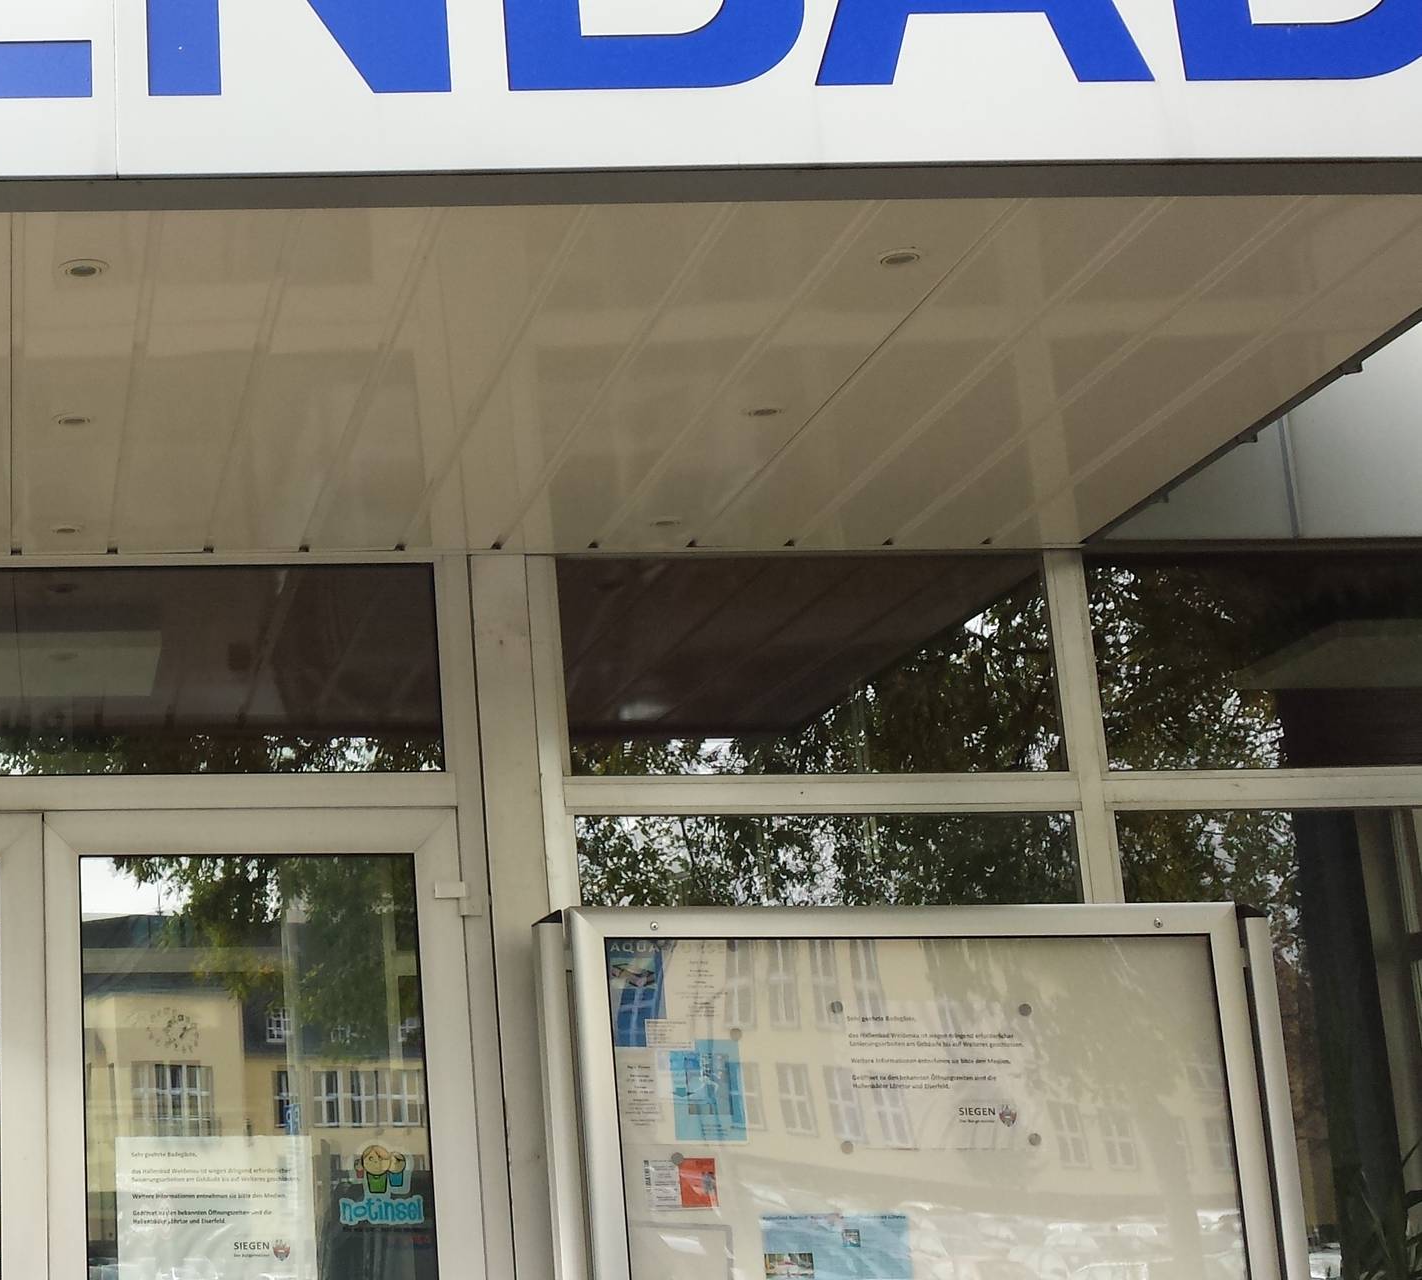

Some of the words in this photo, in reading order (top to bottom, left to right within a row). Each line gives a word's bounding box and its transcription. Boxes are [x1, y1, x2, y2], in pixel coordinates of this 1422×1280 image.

[610, 942, 660, 953] AQUA
[958, 1107, 996, 1116] SIEGEN
[341, 1198, 423, 1222] notinsel
[233, 1241, 270, 1250] SIEGEN
